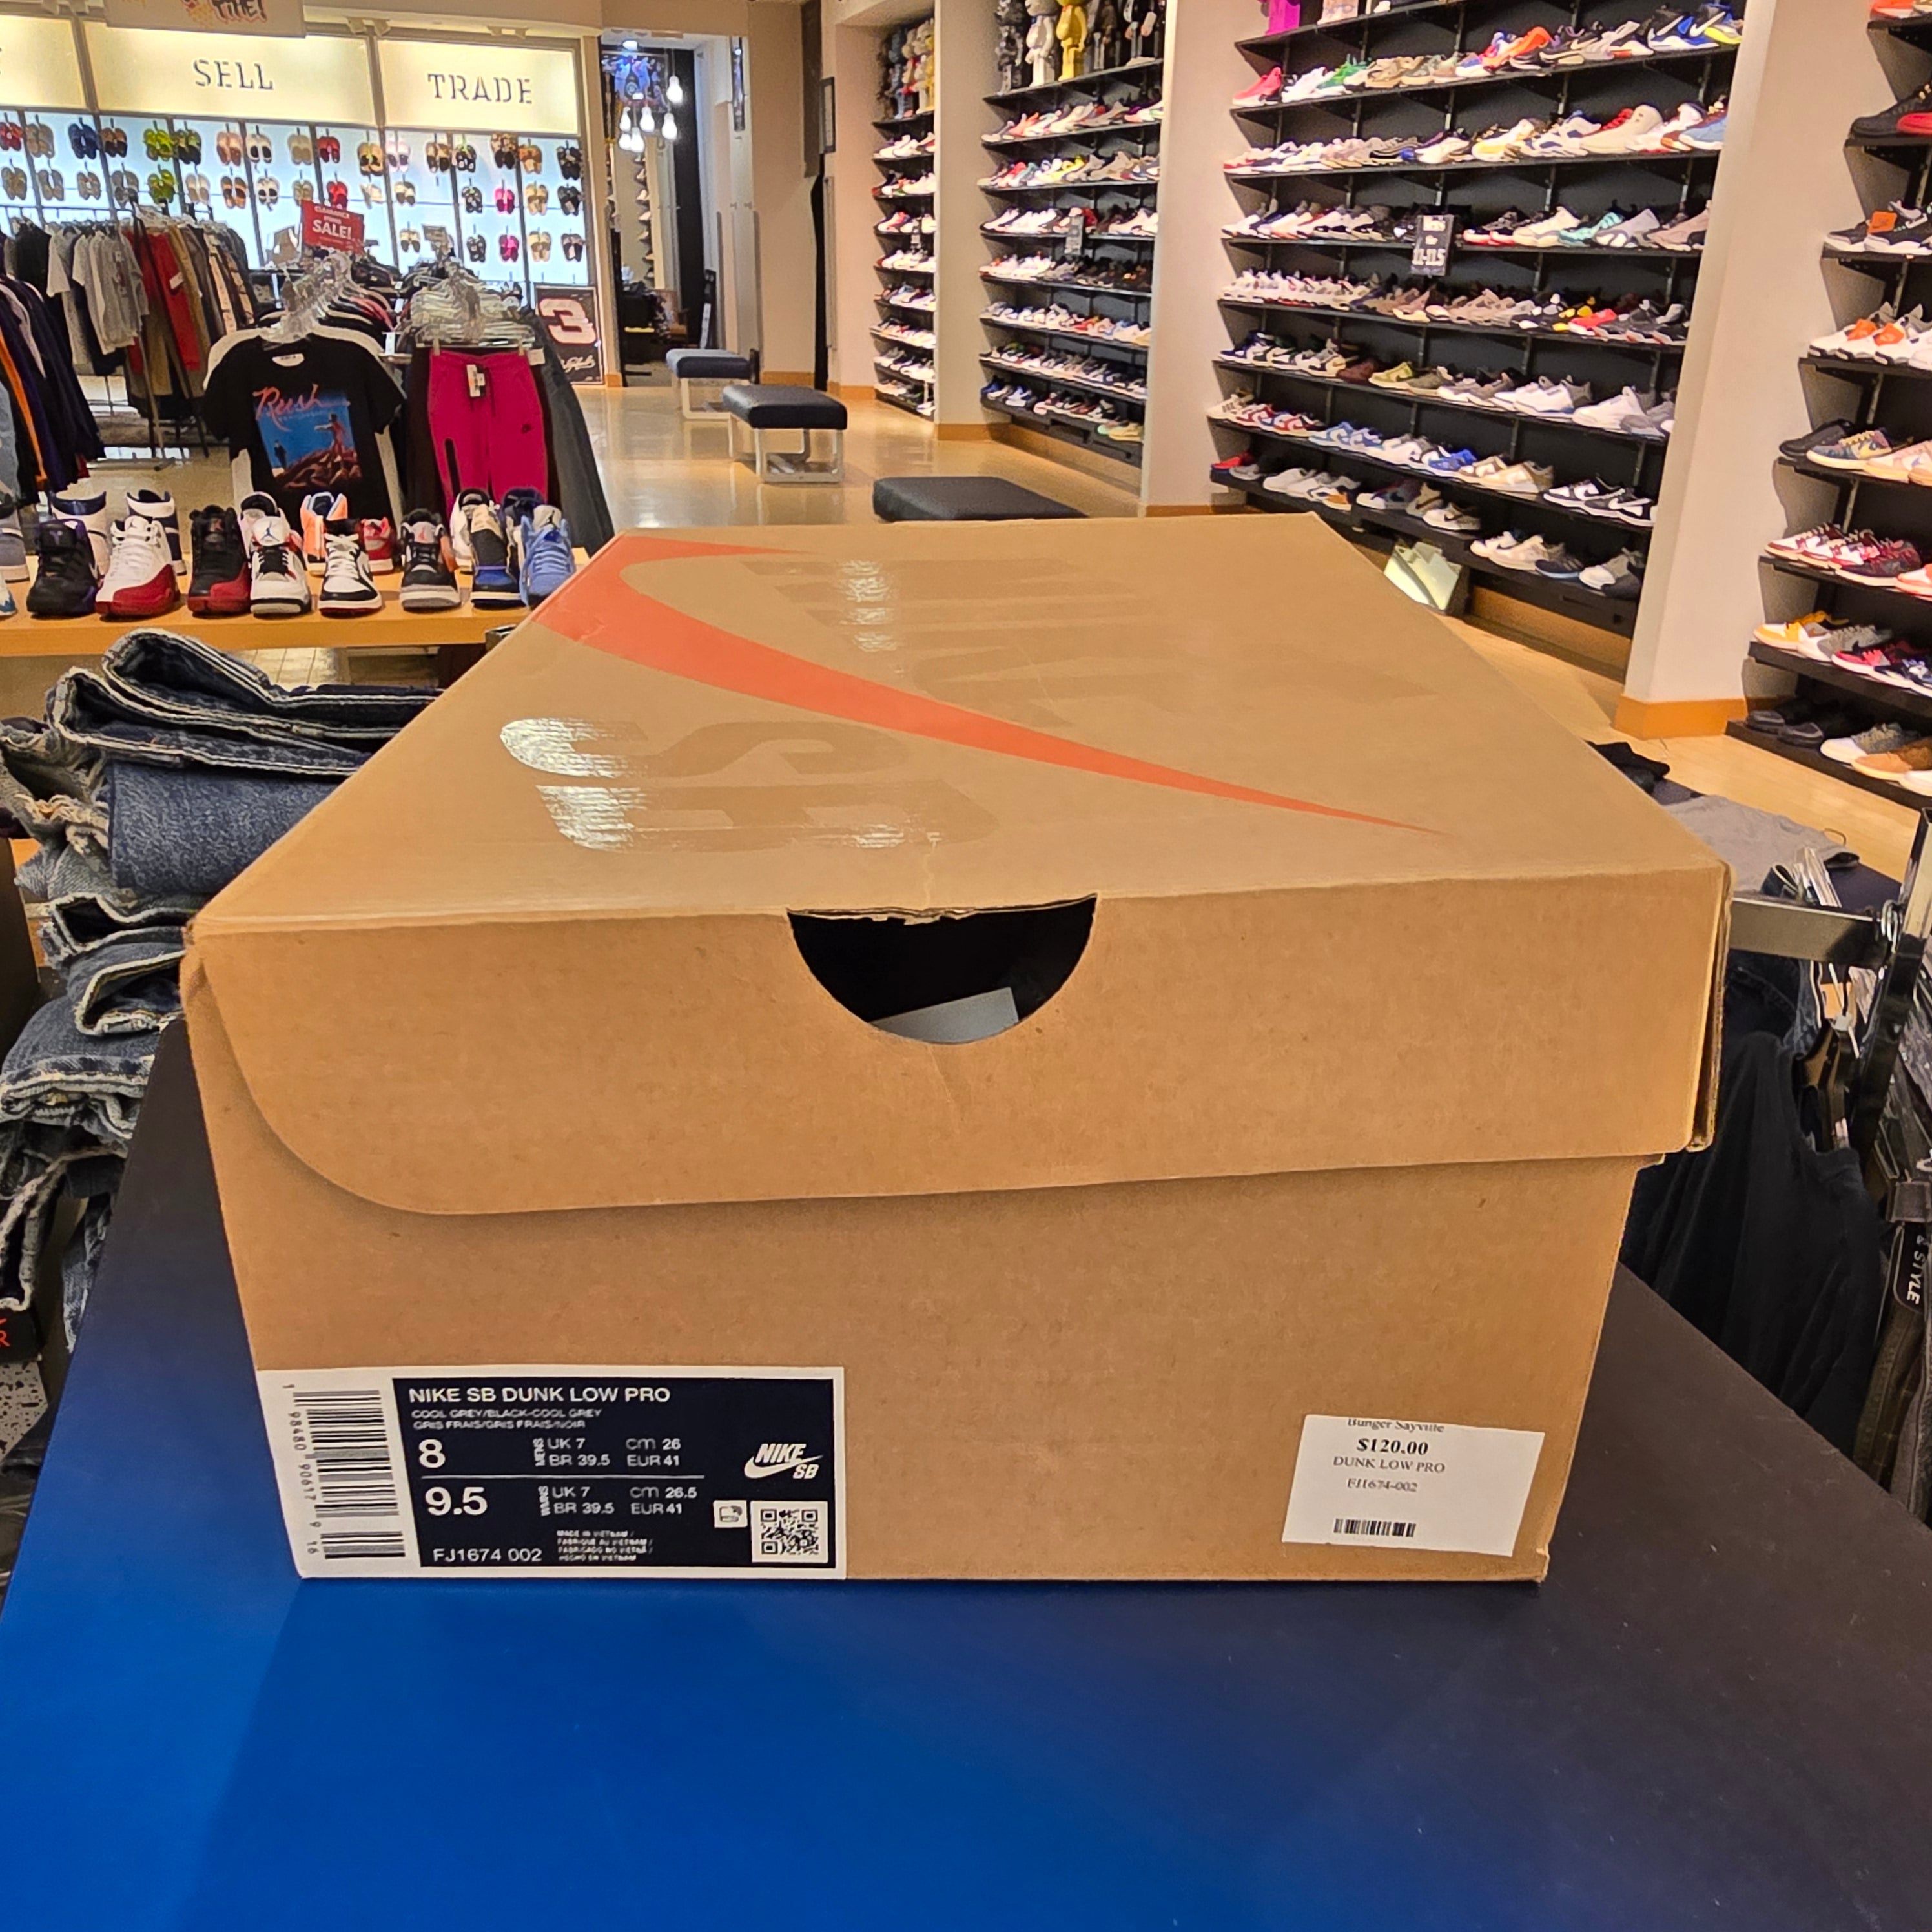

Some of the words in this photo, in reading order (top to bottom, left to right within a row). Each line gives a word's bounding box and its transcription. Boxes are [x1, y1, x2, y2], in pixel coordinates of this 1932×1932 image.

[193, 59, 274, 90] SELL
[427, 74, 532, 104] TRADE
[312, 220, 352, 240] SALE!
[539, 298, 597, 344] 3
[252, 382, 351, 432] Rush
[409, 1387, 462, 1403] NIKE
[467, 1386, 497, 1403] SB
[502, 1387, 564, 1403] DUNK
[570, 1387, 618, 1403] LOW
[624, 1387, 670, 1402] PRO
[411, 1410, 447, 1419] COOL
[568, 1408, 602, 1418] GREY
[413, 1421, 444, 1430] GRIS
[446, 1420, 514, 1430] FRAIS/GRIS
[533, 1437, 546, 1466] MENS
[547, 1438, 571, 1450] UK
[576, 1438, 586, 1449] 7
[662, 1438, 681, 1450] 26
[1357, 1437, 1429, 1455] $120.00
[418, 1439, 446, 1468] 8
[549, 1454, 573, 1466] BR
[577, 1454, 610, 1466] 39.5
[627, 1454, 661, 1467] EUR
[663, 1455, 679, 1466] 41
[754, 1443, 807, 1464] NIKE
[793, 1464, 819, 1479] SB
[1333, 1455, 1375, 1469] DUNK
[1380, 1459, 1413, 1470] LOW
[1416, 1461, 1446, 1473] PRO
[288, 1412, 307, 1451] 98480
[298, 1464, 316, 1501] 90617
[307, 1541, 319, 1554] 16
[552, 1486, 576, 1498] UK
[581, 1486, 590, 1497] 7
[665, 1486, 697, 1499] 26.5
[424, 1486, 488, 1516] 9.5
[553, 1502, 577, 1514] BR
[582, 1502, 615, 1514] 39.5
[631, 1503, 664, 1515] EUR
[666, 1503, 682, 1514] 41
[433, 1548, 501, 1562] FJ1674
[508, 1548, 542, 1562] 002
